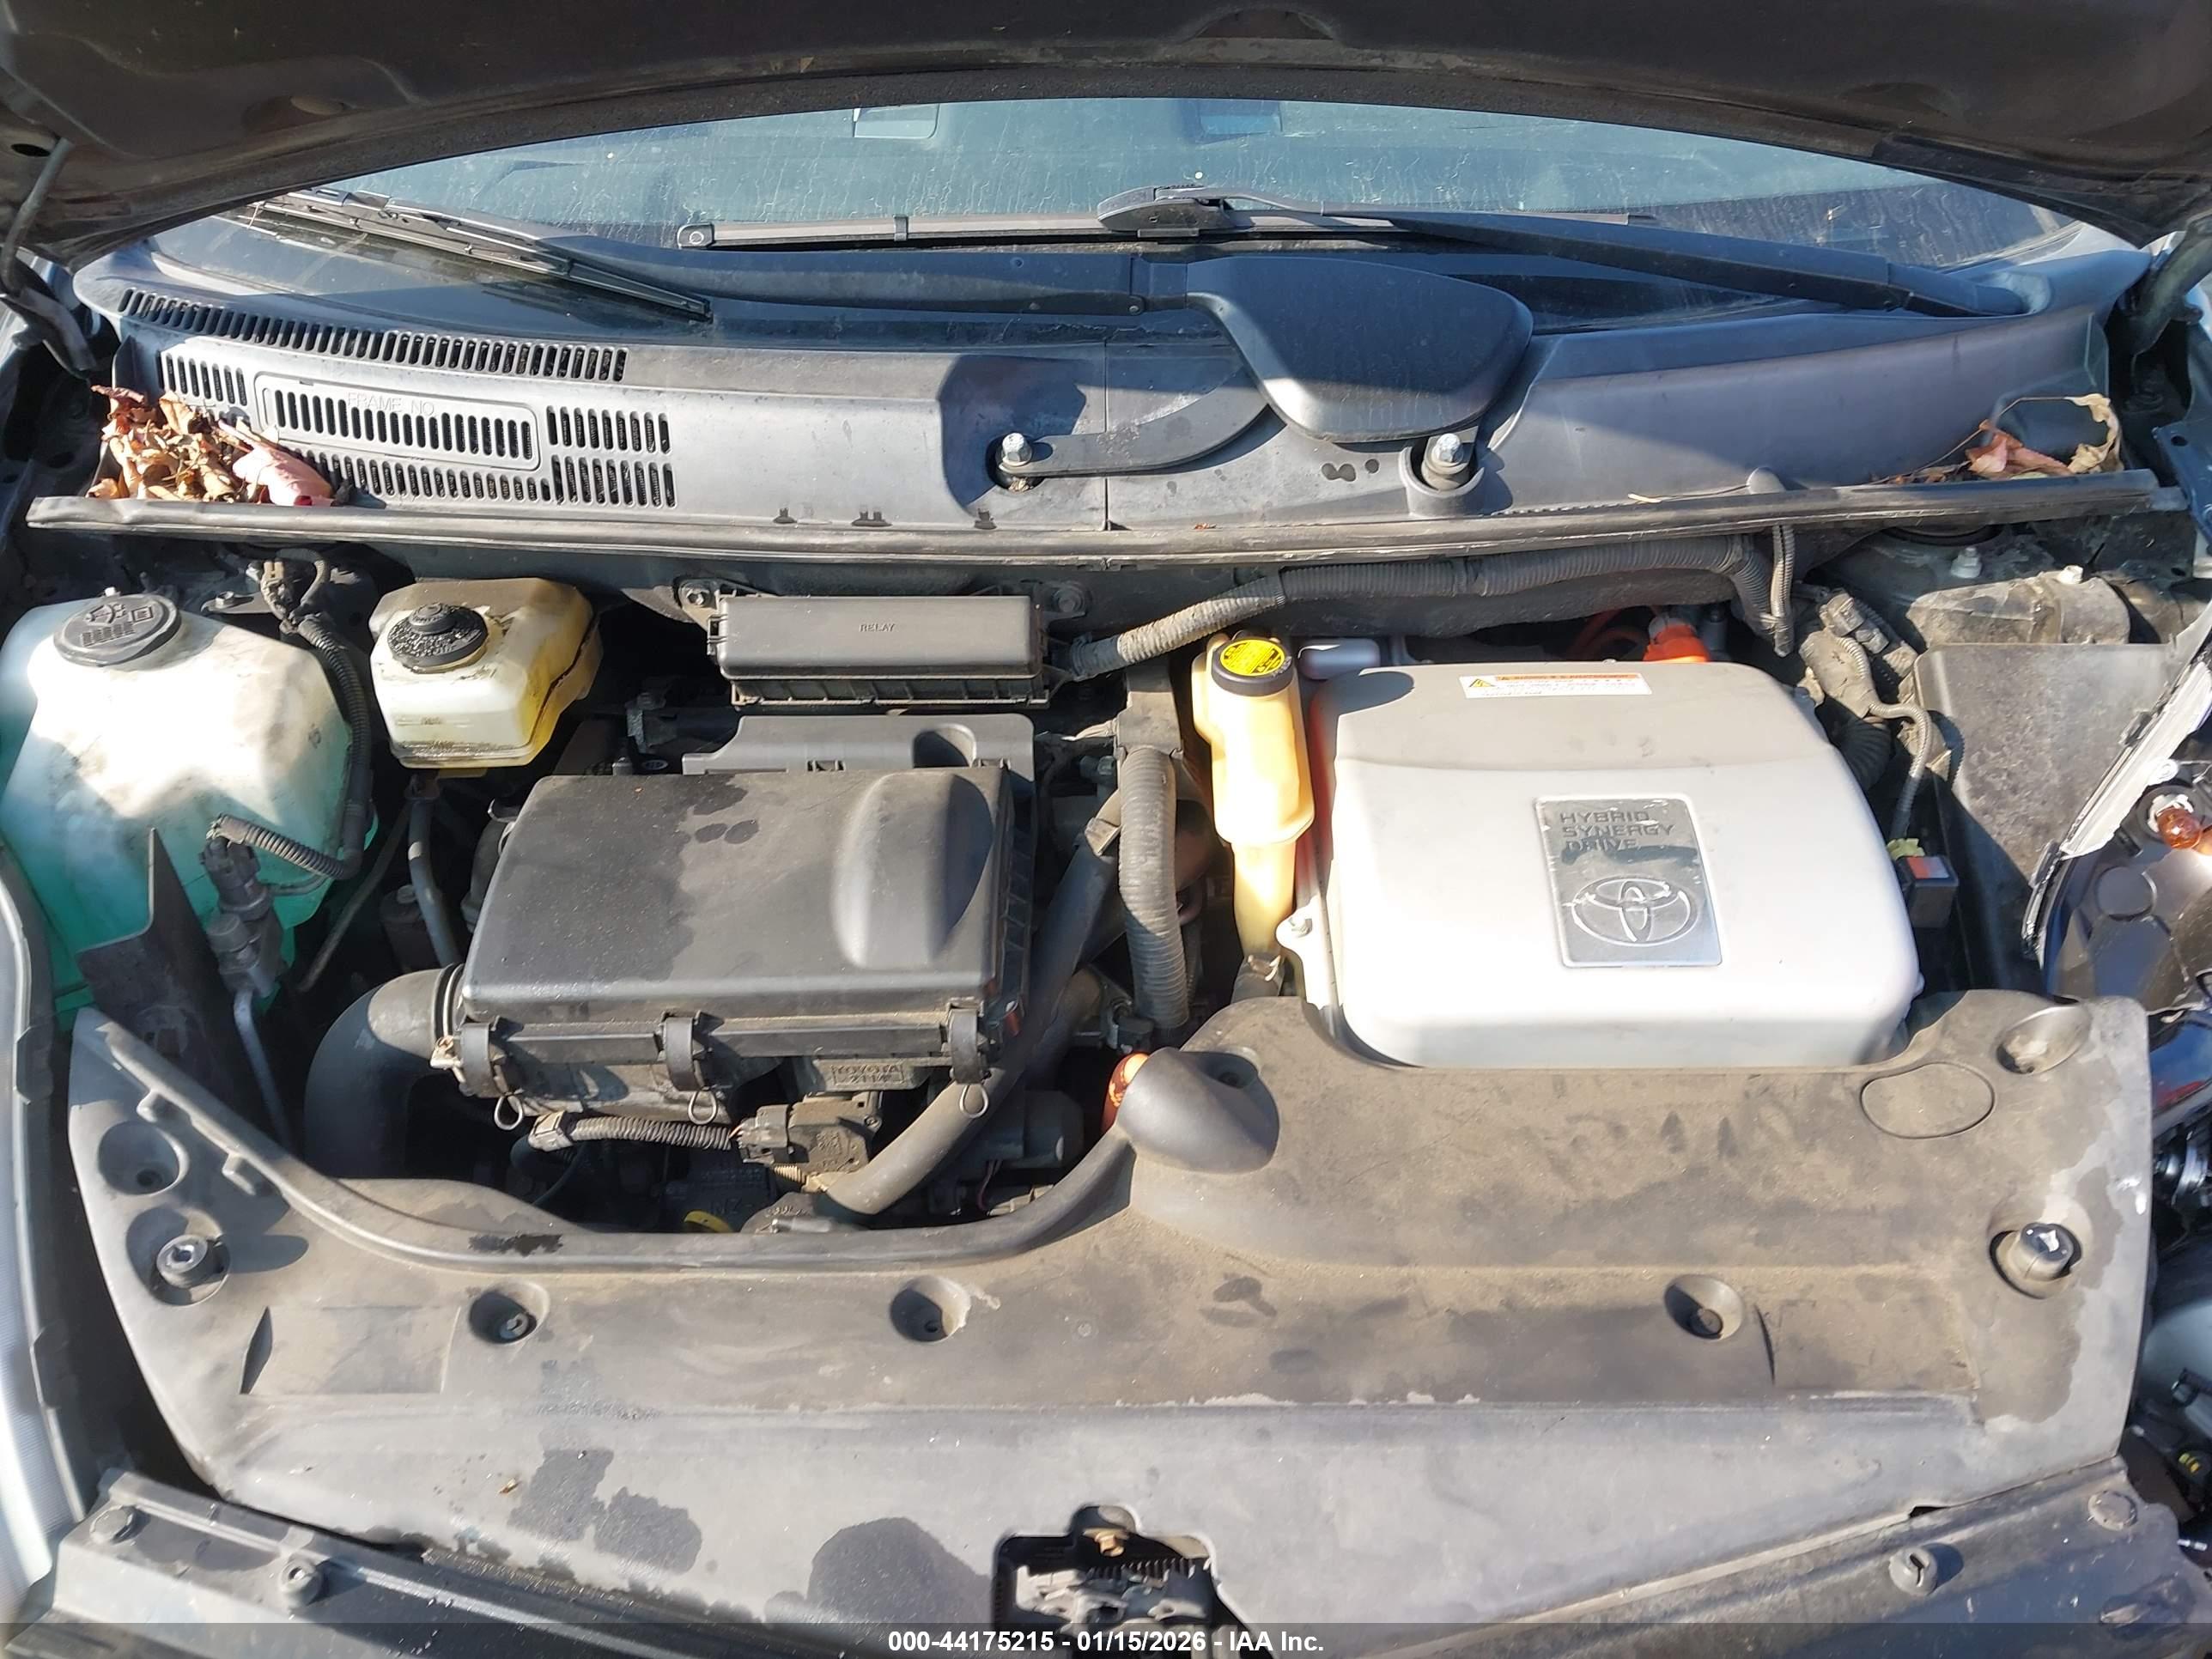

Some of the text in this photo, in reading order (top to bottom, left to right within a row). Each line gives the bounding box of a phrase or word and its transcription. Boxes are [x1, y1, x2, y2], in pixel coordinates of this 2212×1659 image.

[347, 392, 402, 413] FRAME
[859, 623, 896, 633] RELAY
[1560, 811, 1650, 823] HYBRID
[1562, 824, 1675, 838] SYNERGY
[1565, 838, 1638, 852] DRIVE
[832, 1064, 899, 1075] TOYOTA
